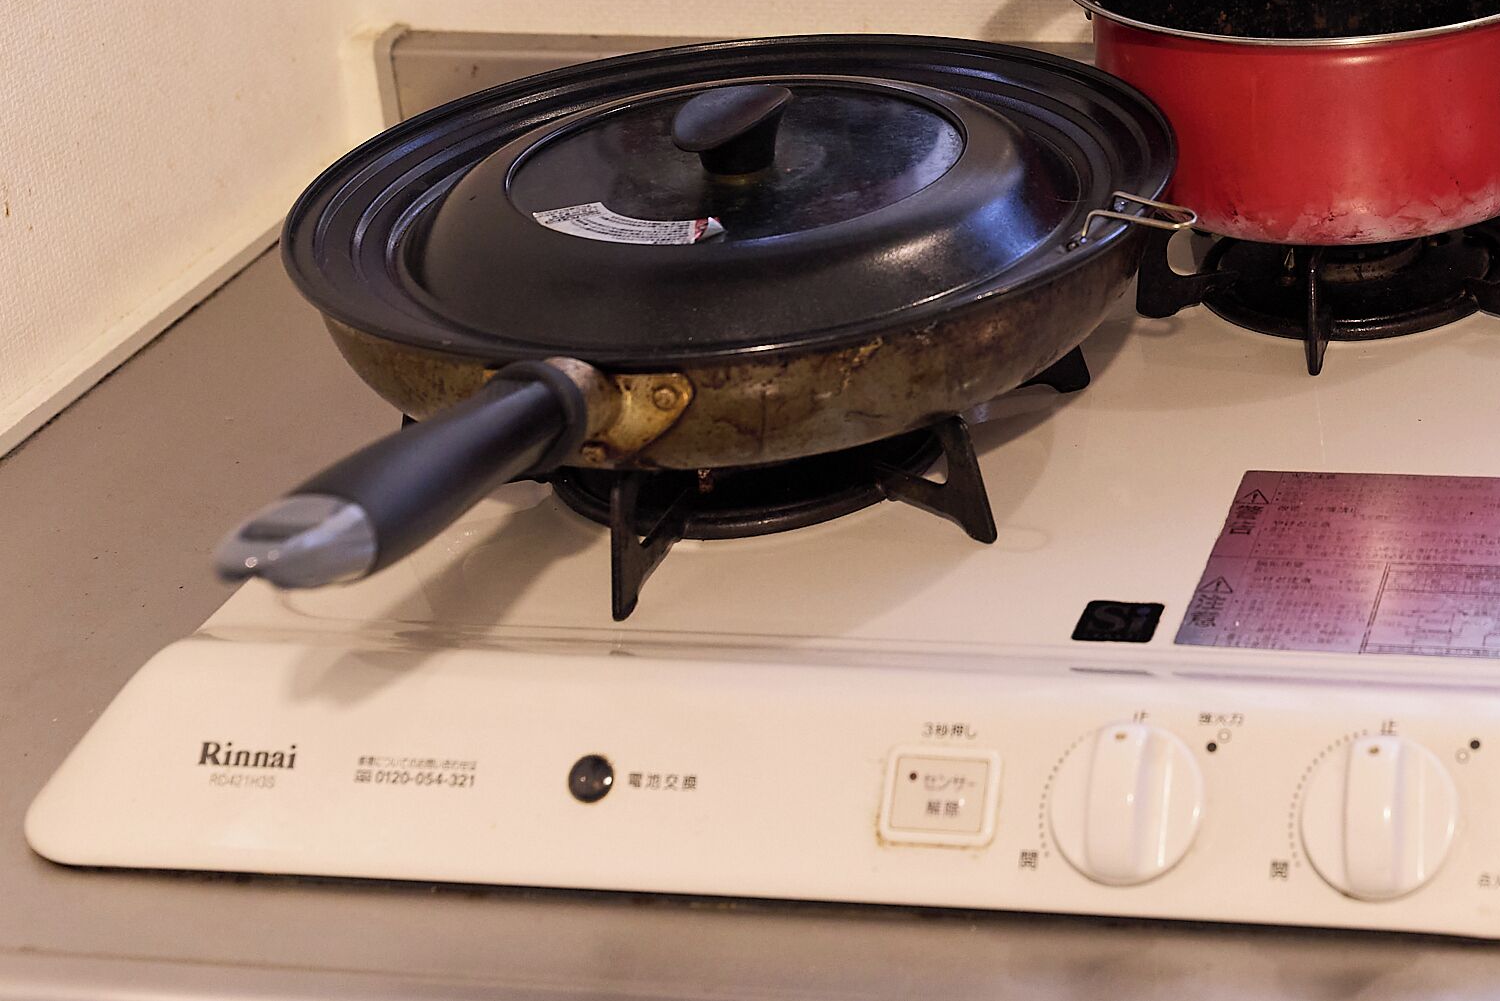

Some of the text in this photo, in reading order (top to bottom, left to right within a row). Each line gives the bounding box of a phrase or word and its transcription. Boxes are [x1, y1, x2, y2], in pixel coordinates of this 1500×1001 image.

[1187, 594, 1227, 628] 注意
[199, 741, 297, 769] Rinnai
[628, 772, 697, 790] 電池交換
[924, 774, 976, 792] センサー
